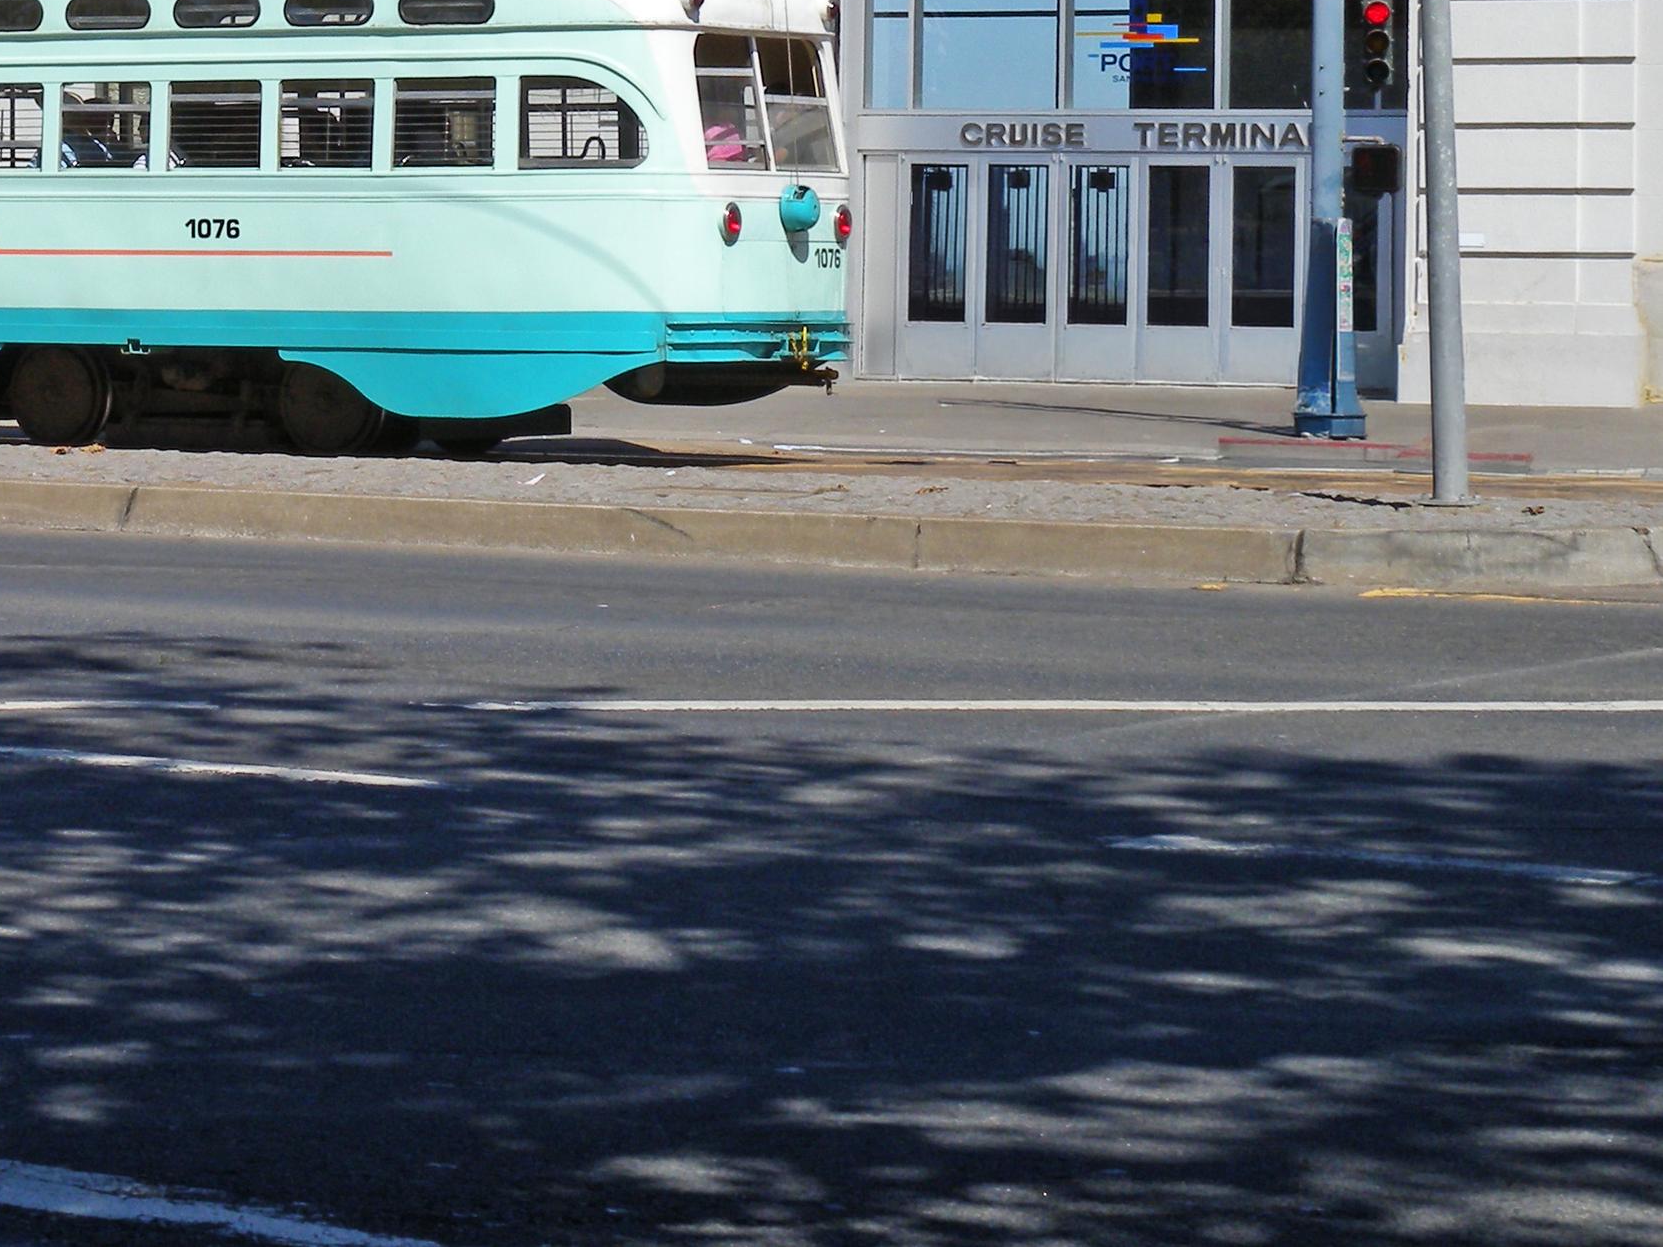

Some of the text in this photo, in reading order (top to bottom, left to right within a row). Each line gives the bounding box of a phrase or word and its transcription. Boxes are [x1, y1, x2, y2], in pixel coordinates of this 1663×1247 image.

[959, 122, 1312, 147] CRUISE TERMINA
[184, 218, 241, 239] 1076
[814, 248, 841, 269] 1076
